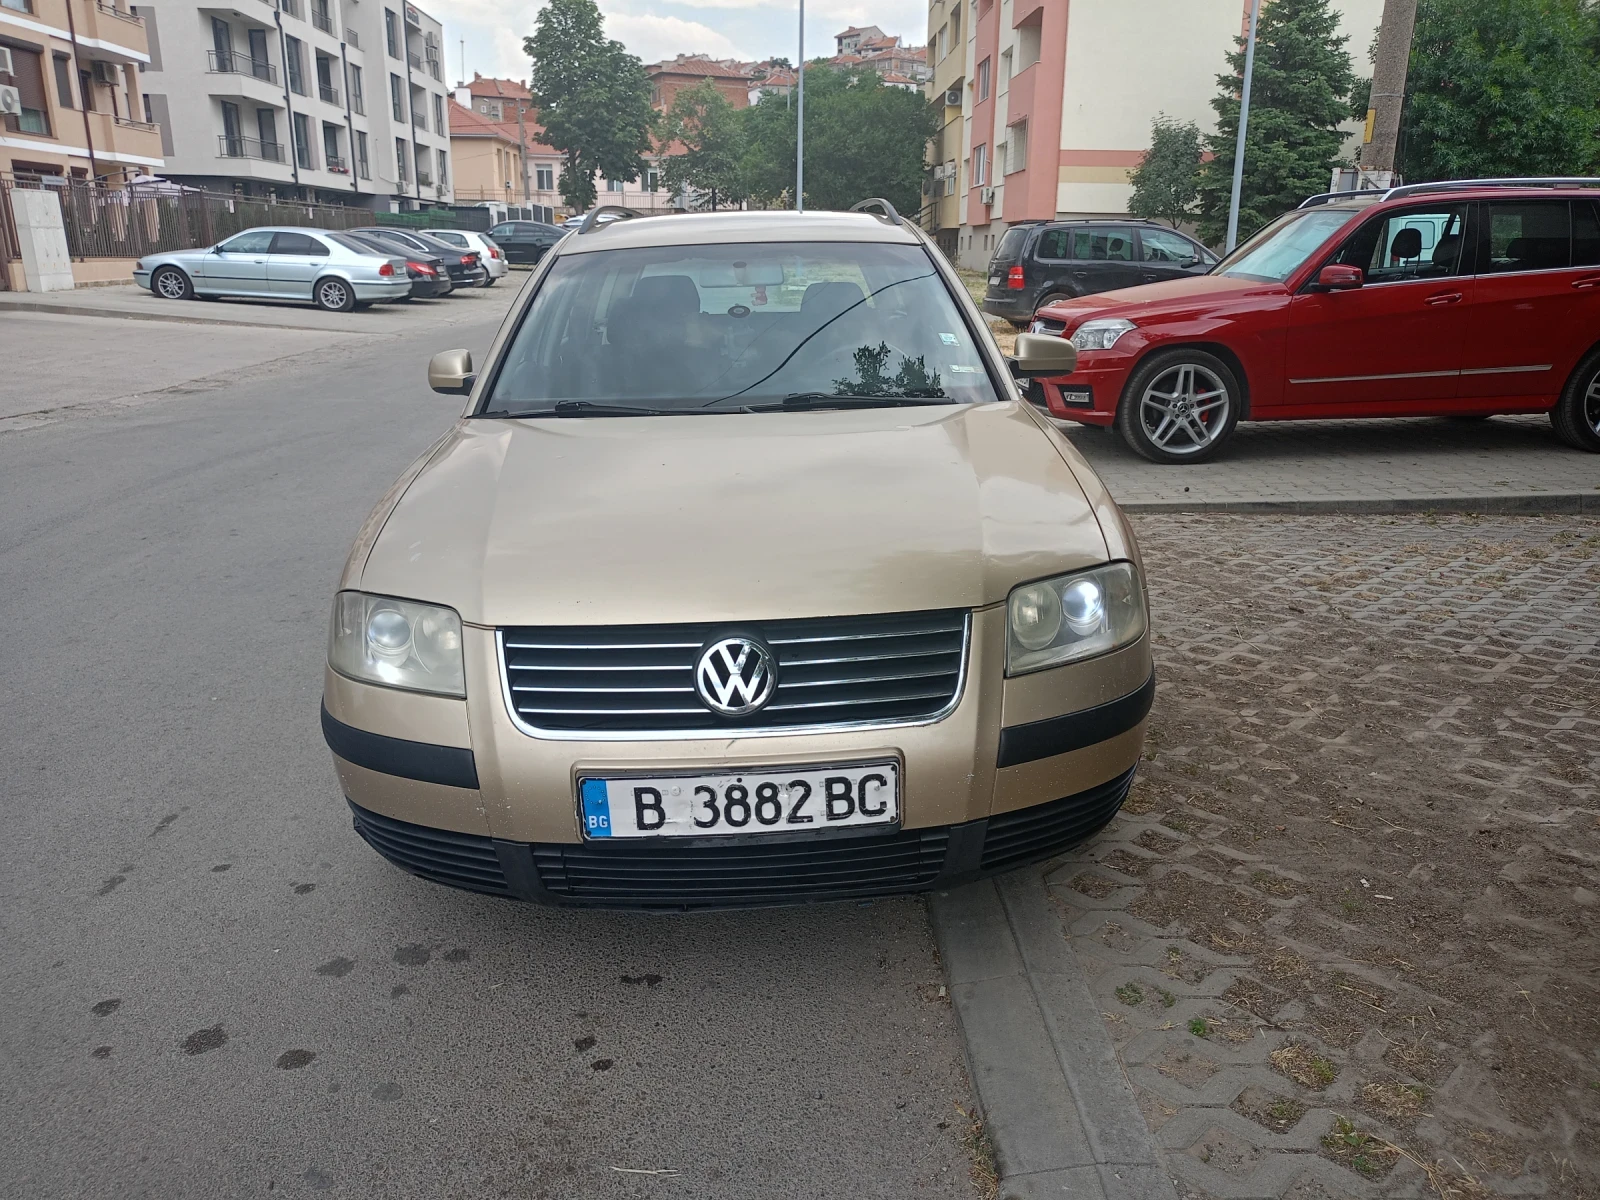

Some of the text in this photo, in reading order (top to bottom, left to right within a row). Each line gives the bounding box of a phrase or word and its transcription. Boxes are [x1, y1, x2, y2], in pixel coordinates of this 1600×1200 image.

[698, 638, 774, 714] VW
[588, 815, 608, 829] BG
[633, 773, 888, 831] B 3882 BC
